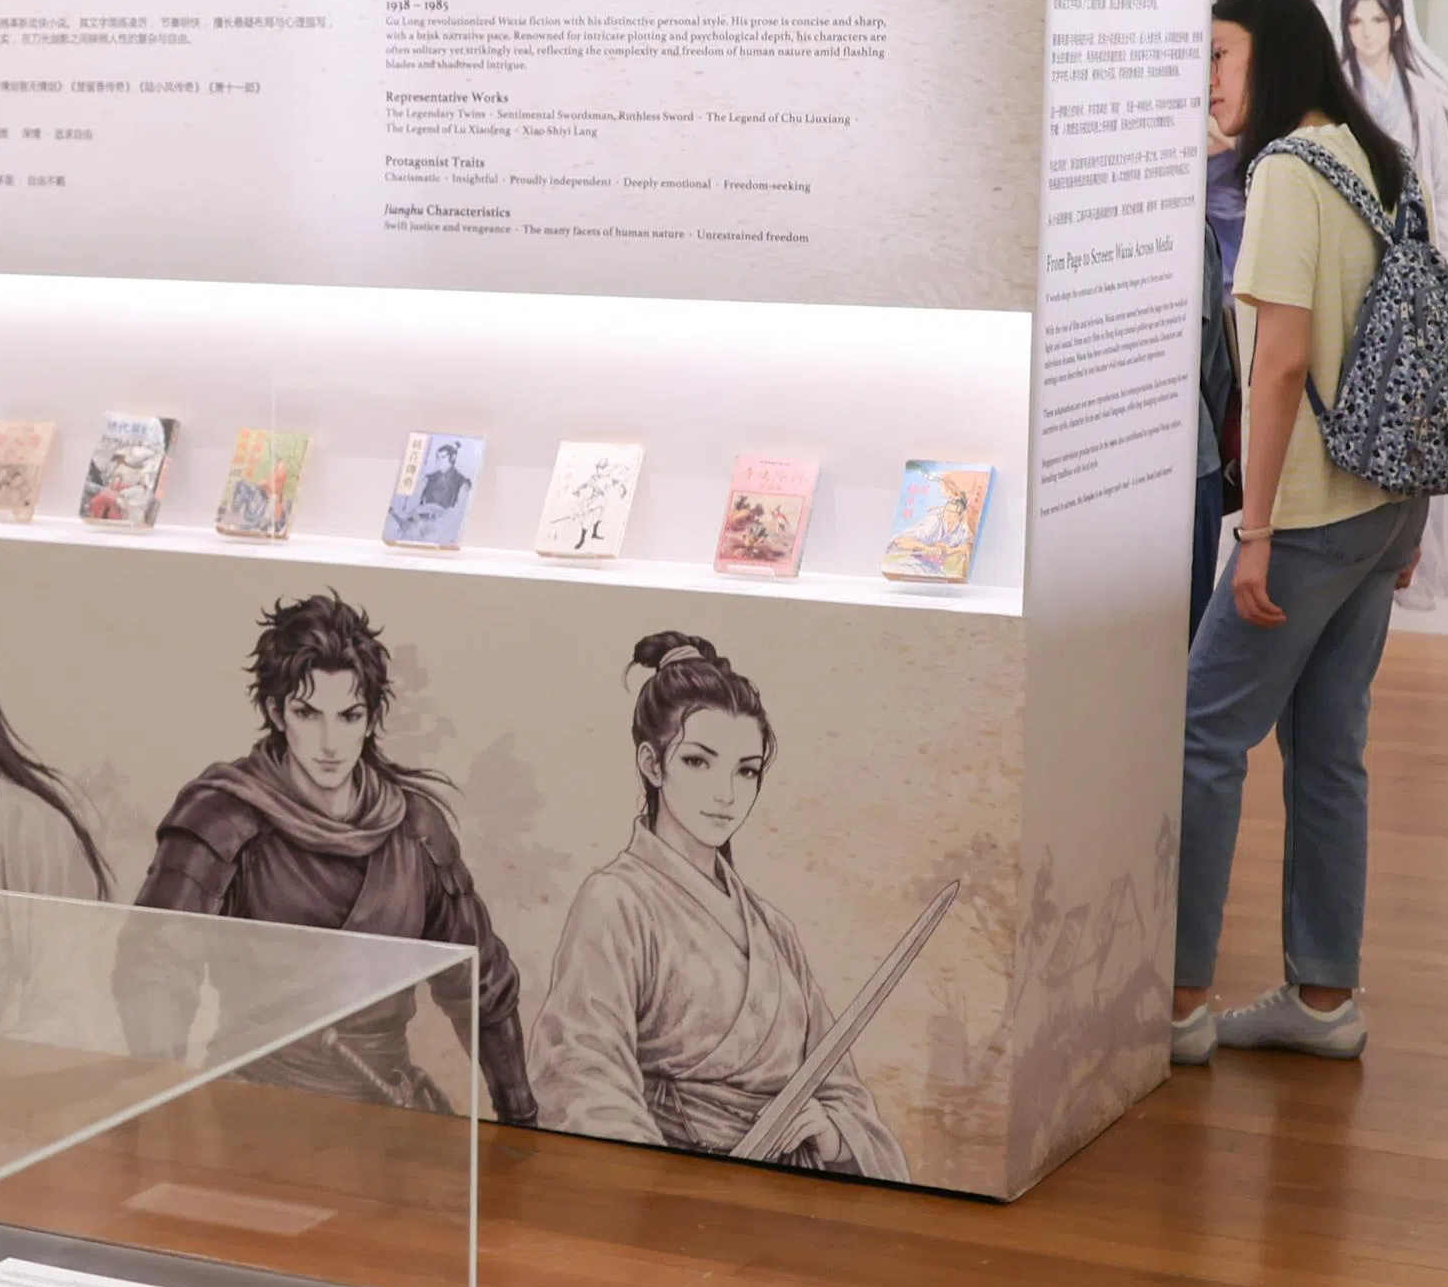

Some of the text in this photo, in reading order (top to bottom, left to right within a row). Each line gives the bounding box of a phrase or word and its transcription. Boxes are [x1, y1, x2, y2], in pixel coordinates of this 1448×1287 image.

[386, 0, 449, 11] 1938 1985
[386, 16, 887, 30] Gu Long revolutionized Wuxia fiction with his distinctive personal style. His prose is concise and sharp,
[386, 30, 887, 45] with a brisk narrative pace. Renowned for intricate plotting and psychological depth, his characters are
[386, 45, 885, 60] often solitary yet strikingly real, reflecting the complexity and freedom of human nature amid flashing
[386, 90, 508, 107] Representative Works
[386, 108, 850, 127] The Legendary Twins Sentimental Swordsman, Ruthless Sword The Legend of Chu Liuxiang
[386, 124, 598, 140] The Legend of Lu Xiaofeng Xiao Shiyi Lang
[386, 155, 485, 171] Protagonist Traits
[384, 172, 811, 194] Charismatic Insightful Proudly independent Deeply emotional Freedom-seeking
[384, 203, 510, 219] Jianghu Characteristics
[384, 220, 809, 243] Swift justice and vengeance The many facets of human nature Unrestrained freedom
[1047, 252, 1065, 273] From
[1067, 250, 1082, 273] Page
[1083, 249, 1090, 266] to
[1134, 240, 1154, 259] Across
[1155, 235, 1173, 255] Media
